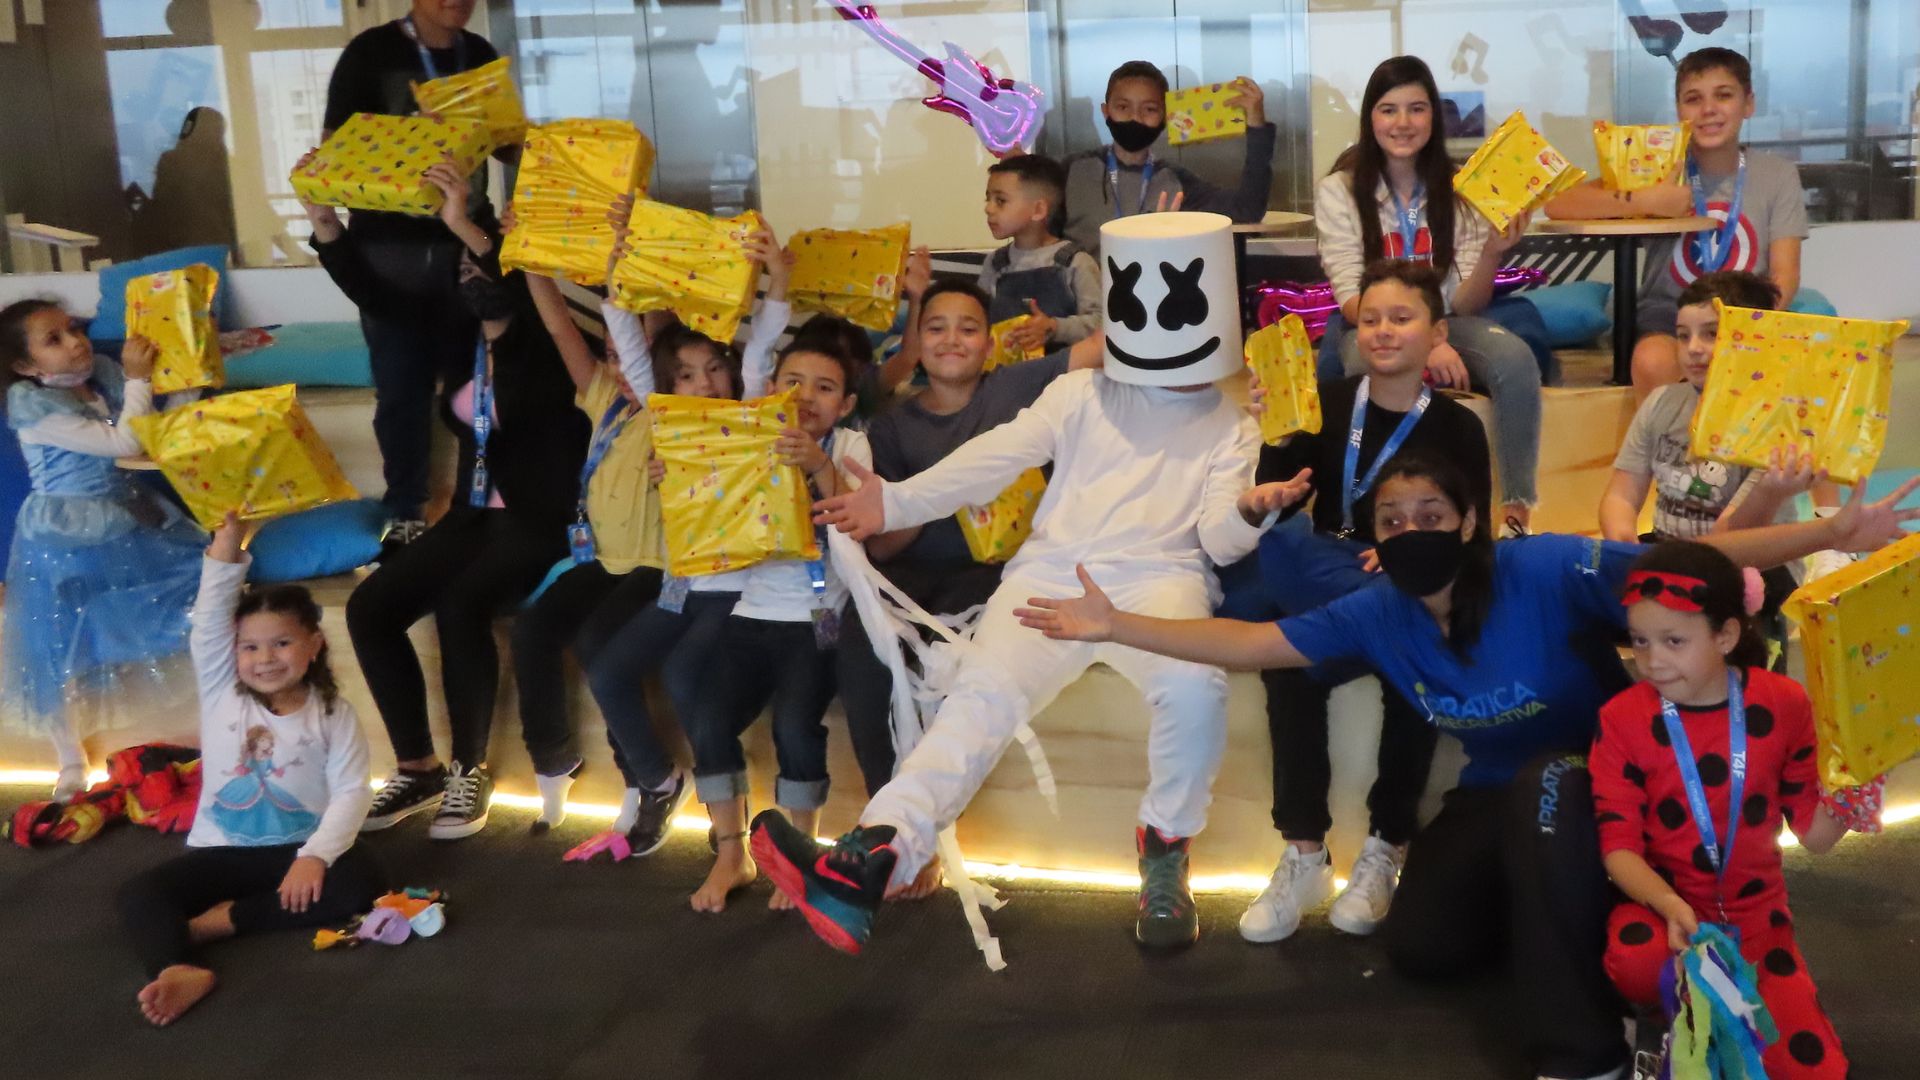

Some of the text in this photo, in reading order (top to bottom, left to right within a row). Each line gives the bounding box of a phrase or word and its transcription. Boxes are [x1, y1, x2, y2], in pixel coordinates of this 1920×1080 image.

[1407, 207, 1418, 226] T4F
[1415, 395, 1432, 413] T4F
[1350, 428, 1364, 449] T4F
[1661, 696, 1680, 717] 4F
[1732, 750, 1747, 779] T4F
